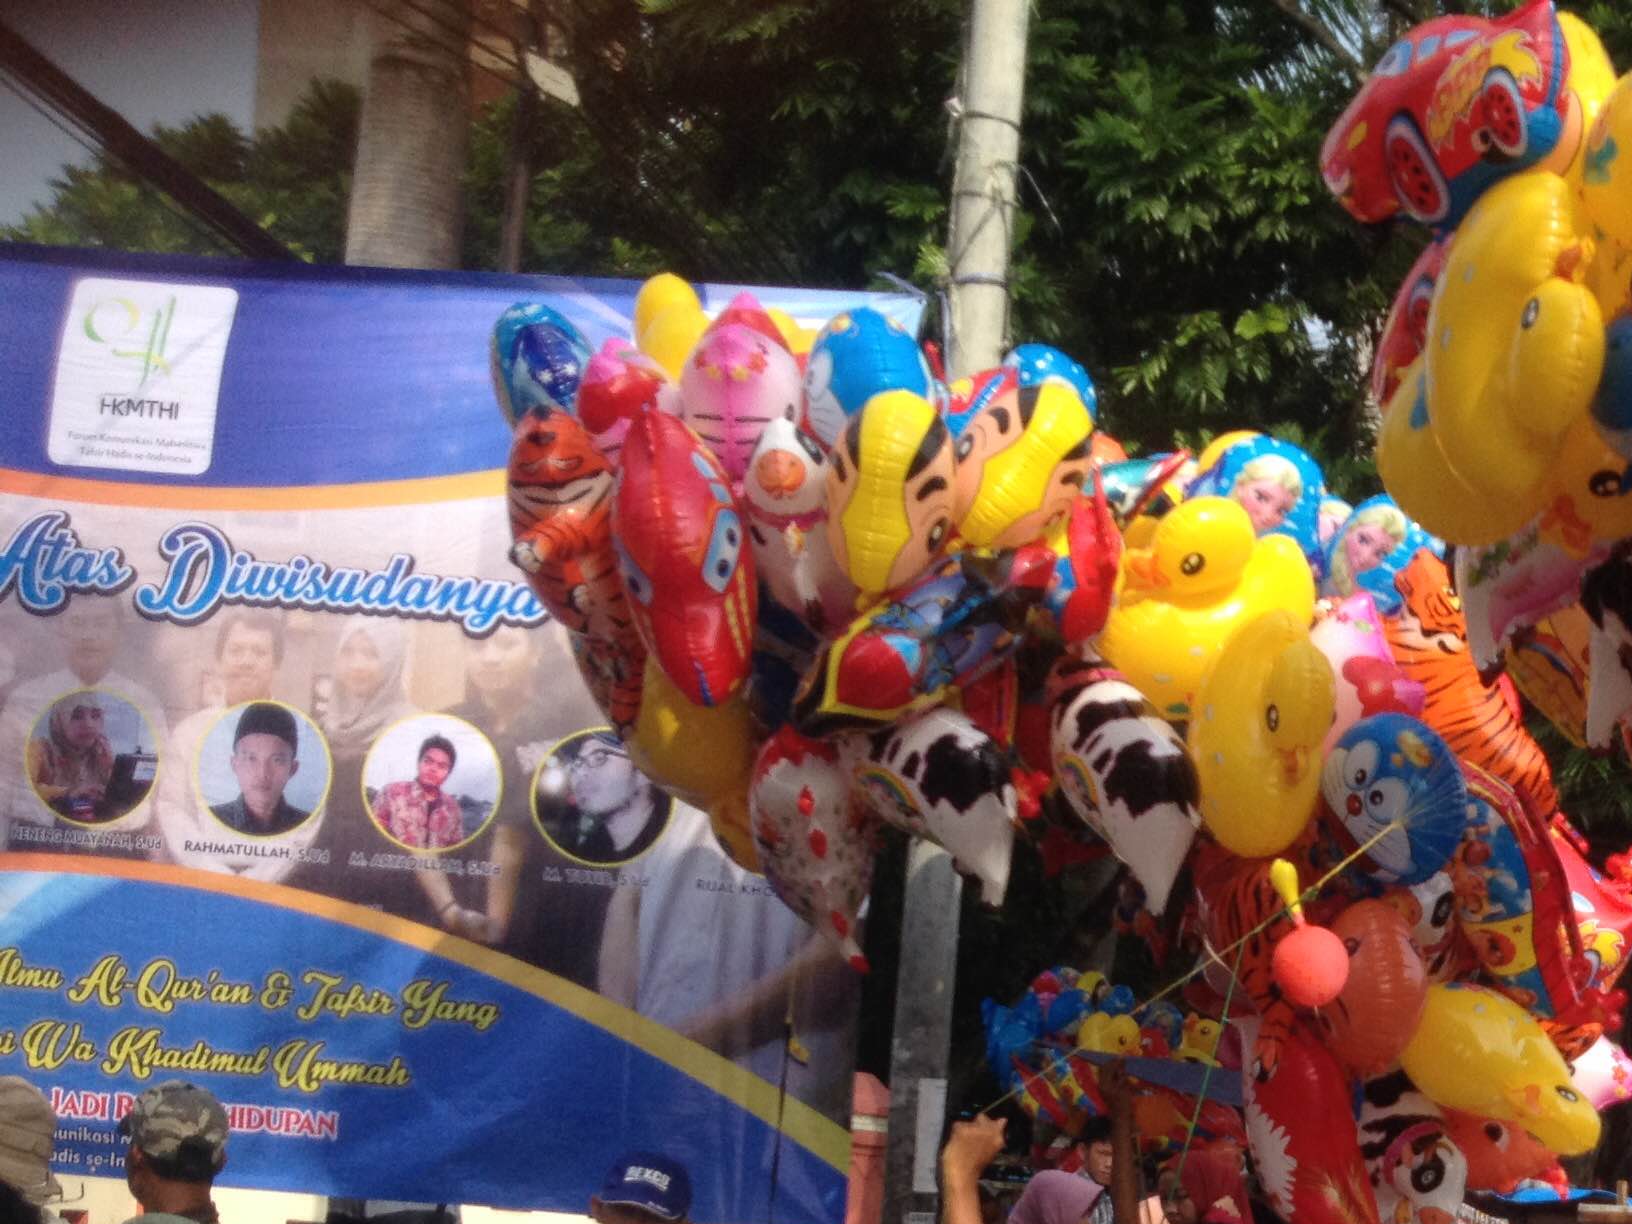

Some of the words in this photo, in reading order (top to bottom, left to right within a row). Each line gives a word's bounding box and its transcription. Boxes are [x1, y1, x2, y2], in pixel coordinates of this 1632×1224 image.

[0, 511, 133, 611] Atas
[137, 520, 547, 638] Diwisudanya
[68, 954, 254, 1013] Al-Qur'an
[259, 972, 294, 1009] &
[297, 971, 396, 1020] Tafsir
[399, 980, 500, 1030] Yang
[22, 1020, 97, 1070] Wa
[102, 1024, 269, 1079] Khadimul
[271, 1038, 412, 1093] Ummah
[86, 1151, 127, 1168] se-In
